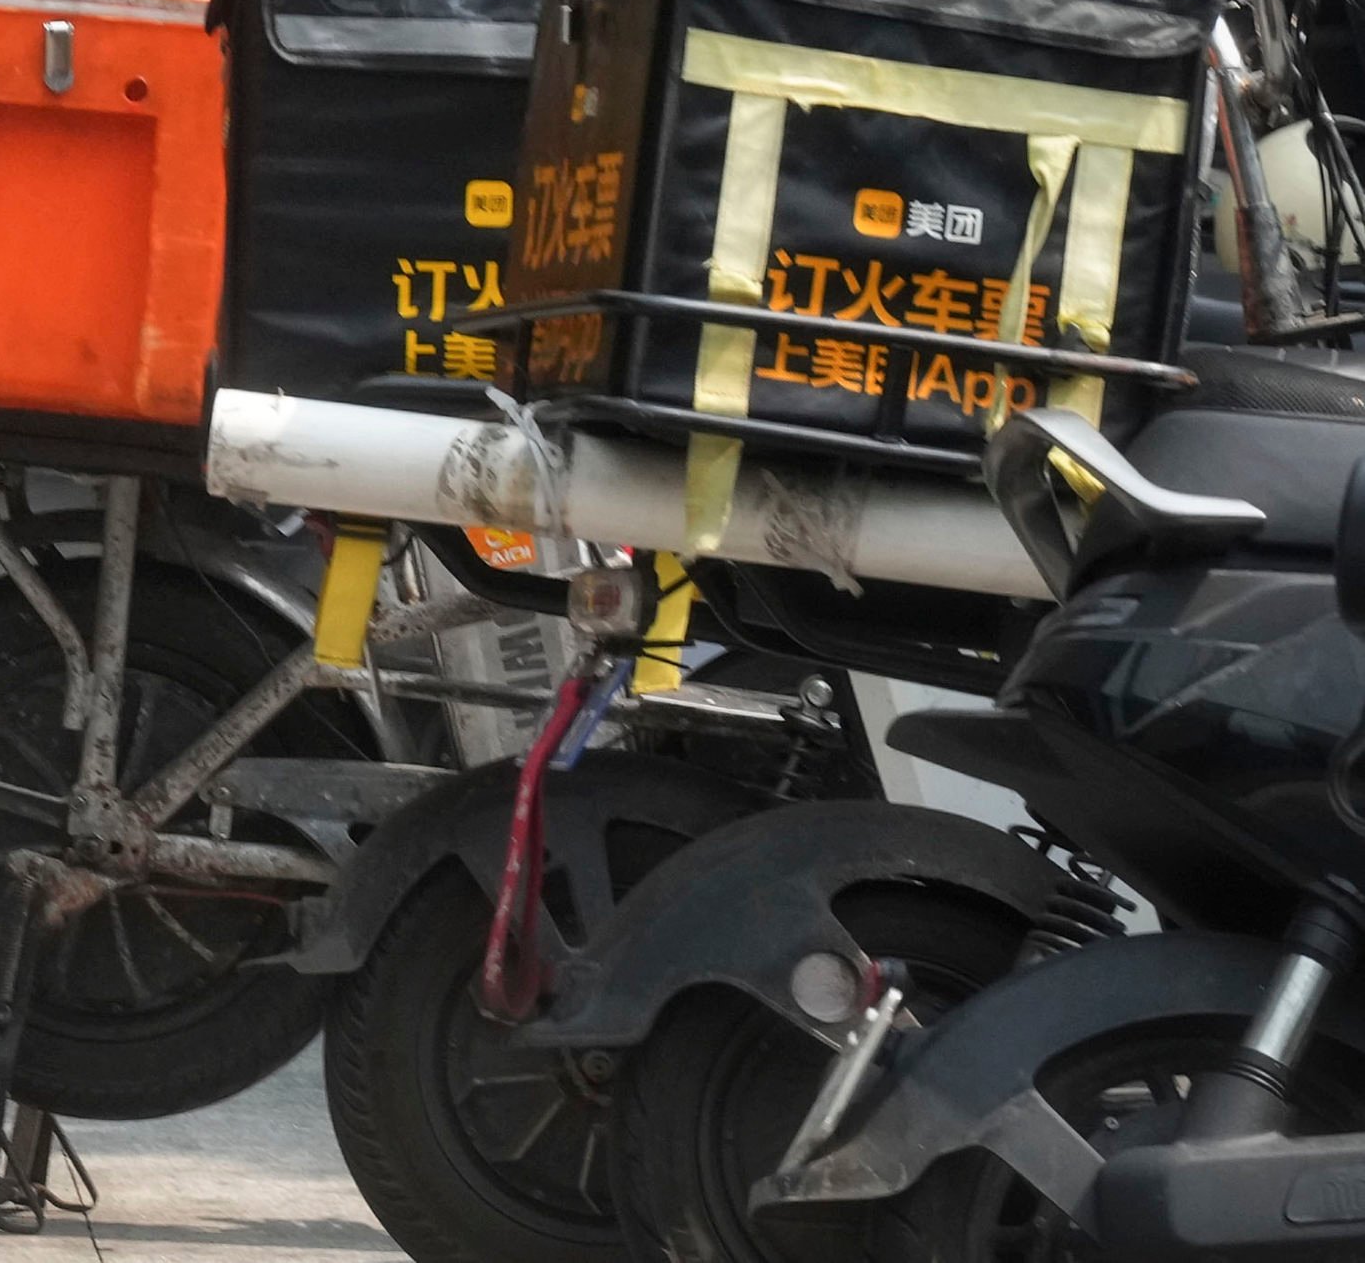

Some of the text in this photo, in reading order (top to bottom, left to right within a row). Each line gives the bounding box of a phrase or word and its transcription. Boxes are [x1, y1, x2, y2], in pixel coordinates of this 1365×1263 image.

[906, 198, 985, 246] 美团
[767, 247, 1052, 348] 订火车票
